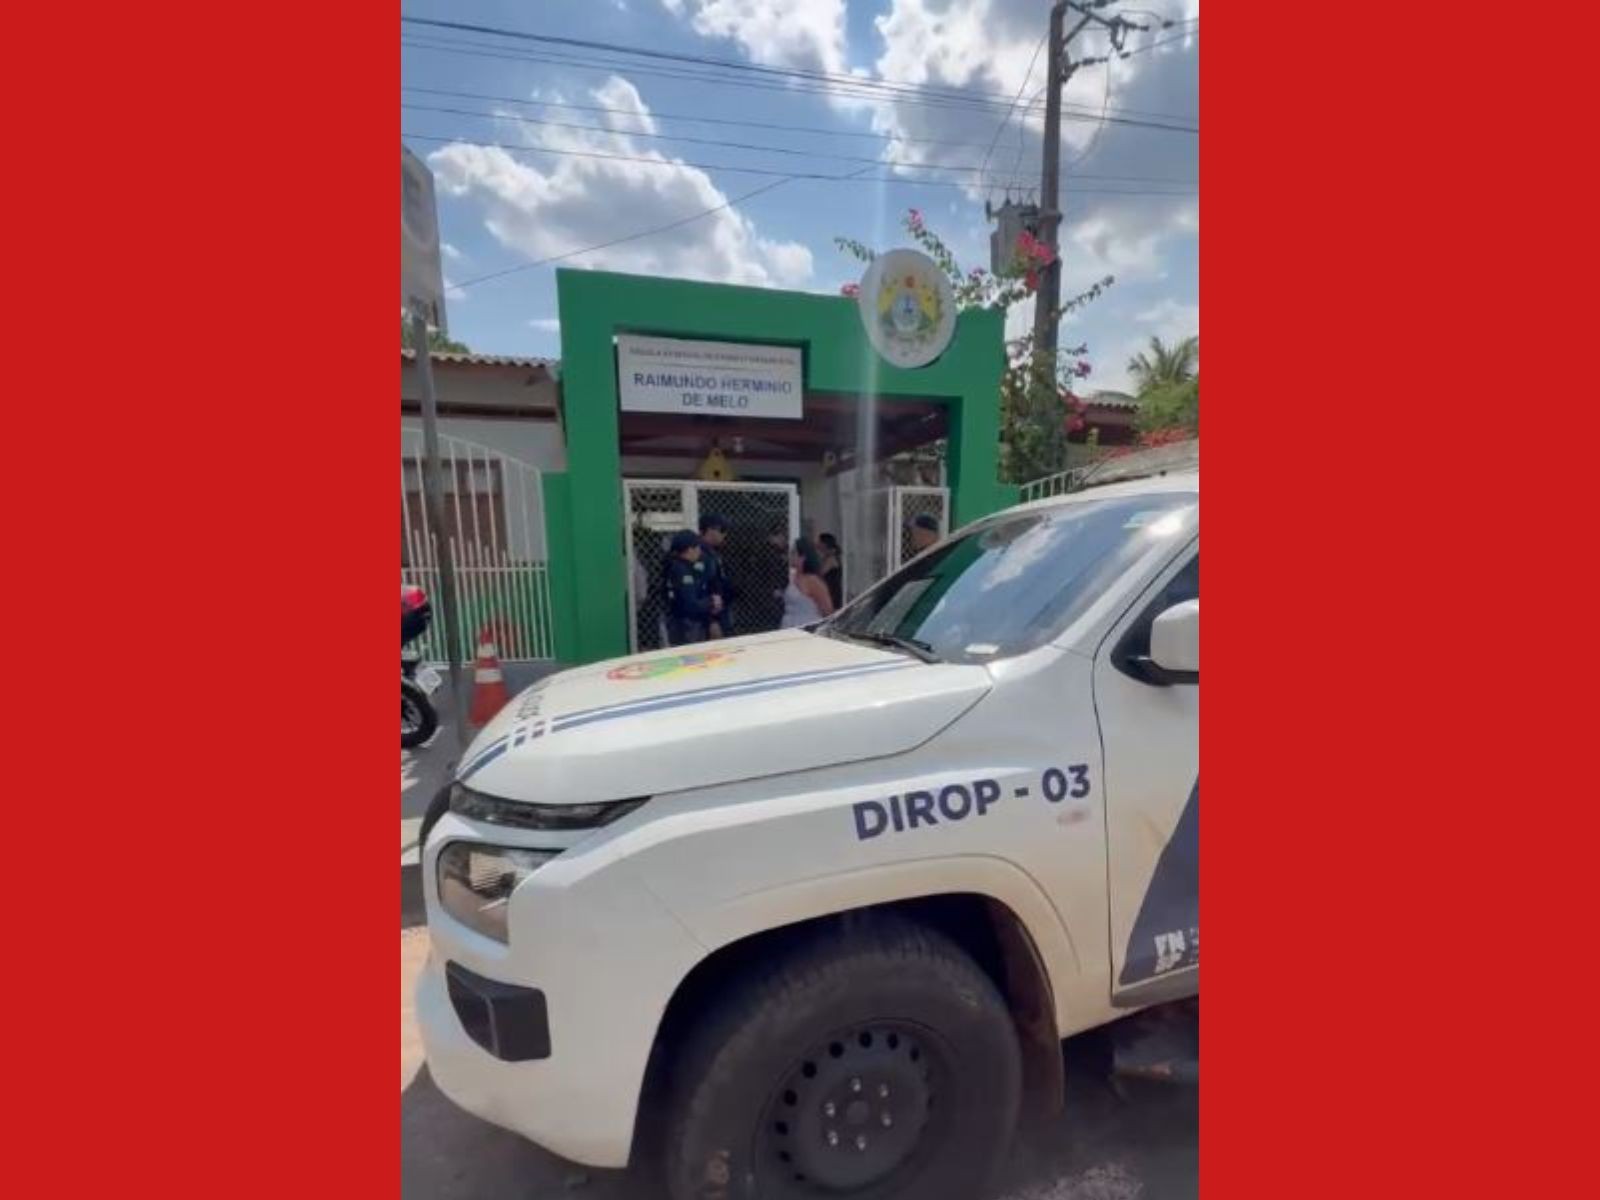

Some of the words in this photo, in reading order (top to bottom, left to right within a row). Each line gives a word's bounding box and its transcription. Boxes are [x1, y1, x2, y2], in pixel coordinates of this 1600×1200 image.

[633, 373, 717, 390] RAIMUNDO
[682, 393, 702, 407] DE
[707, 394, 748, 408] MELO
[853, 779, 1001, 840] DIROP
[1042, 764, 1091, 802] 03
